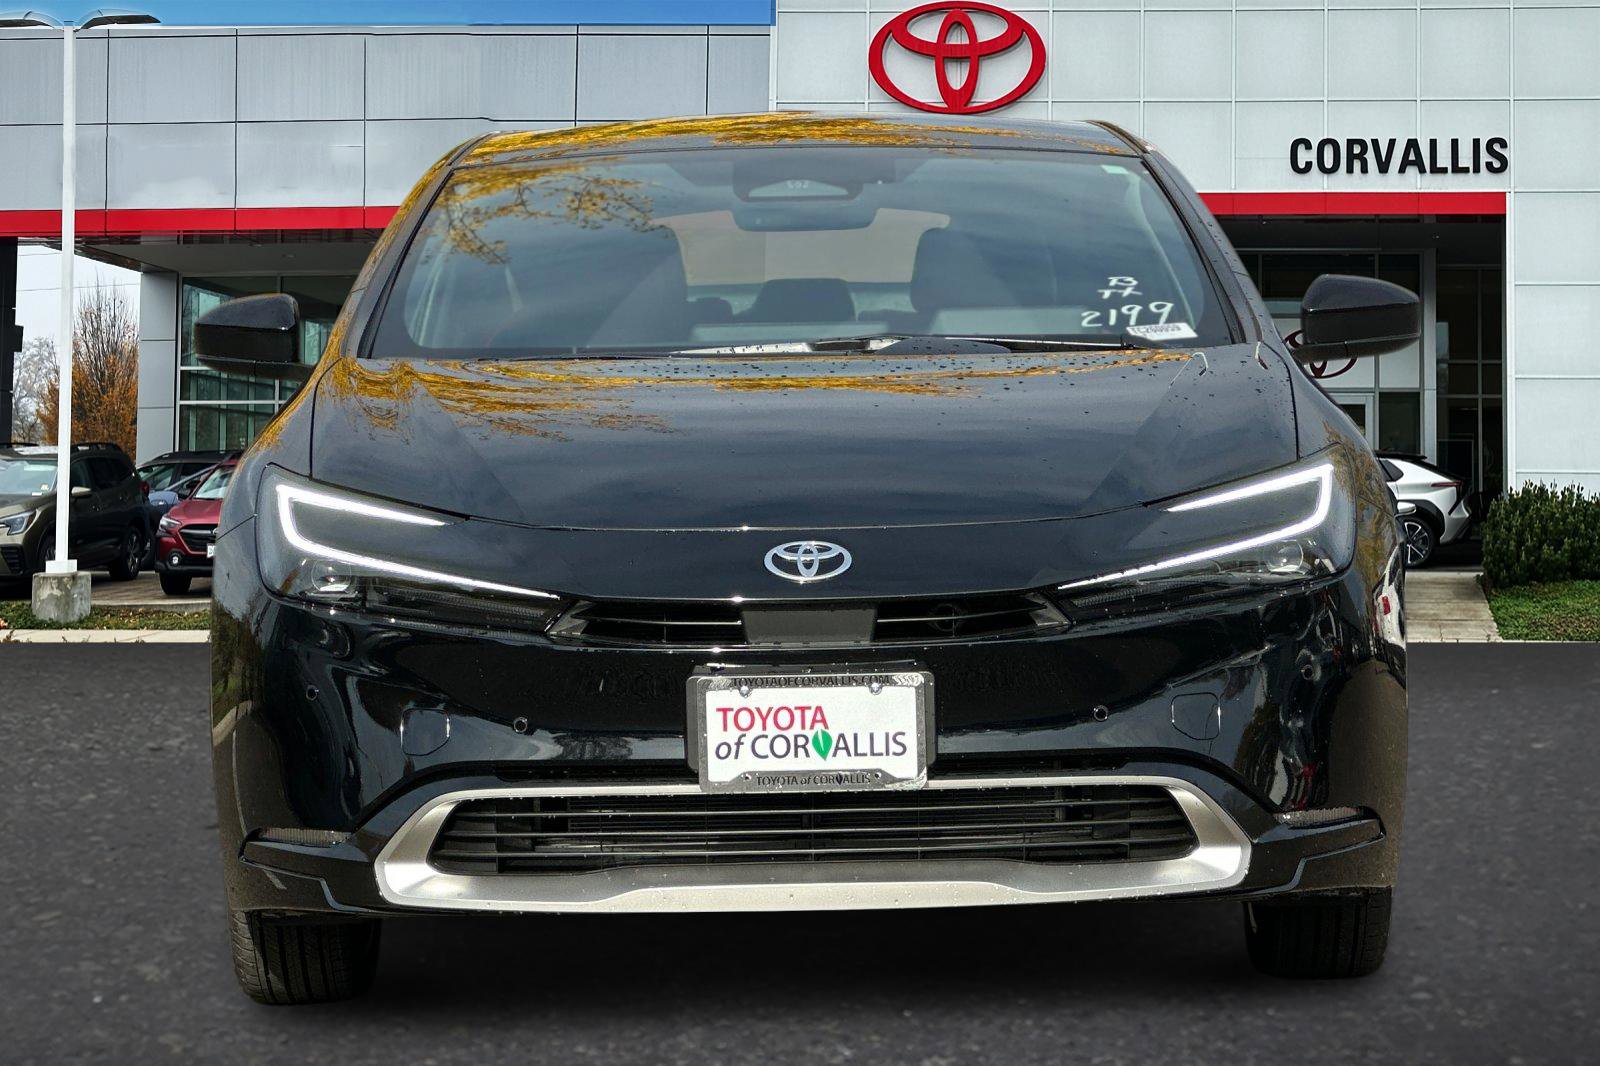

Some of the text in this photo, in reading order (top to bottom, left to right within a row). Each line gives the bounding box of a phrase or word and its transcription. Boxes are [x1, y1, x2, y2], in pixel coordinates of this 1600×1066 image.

[1289, 137, 1509, 174] CORVALLIS
[1081, 301, 1175, 328] 2199
[716, 705, 830, 732] TOYOTA
[715, 730, 908, 761] of CORVALLIS
[756, 775, 799, 786] TOYOTA
[800, 775, 812, 785] of
